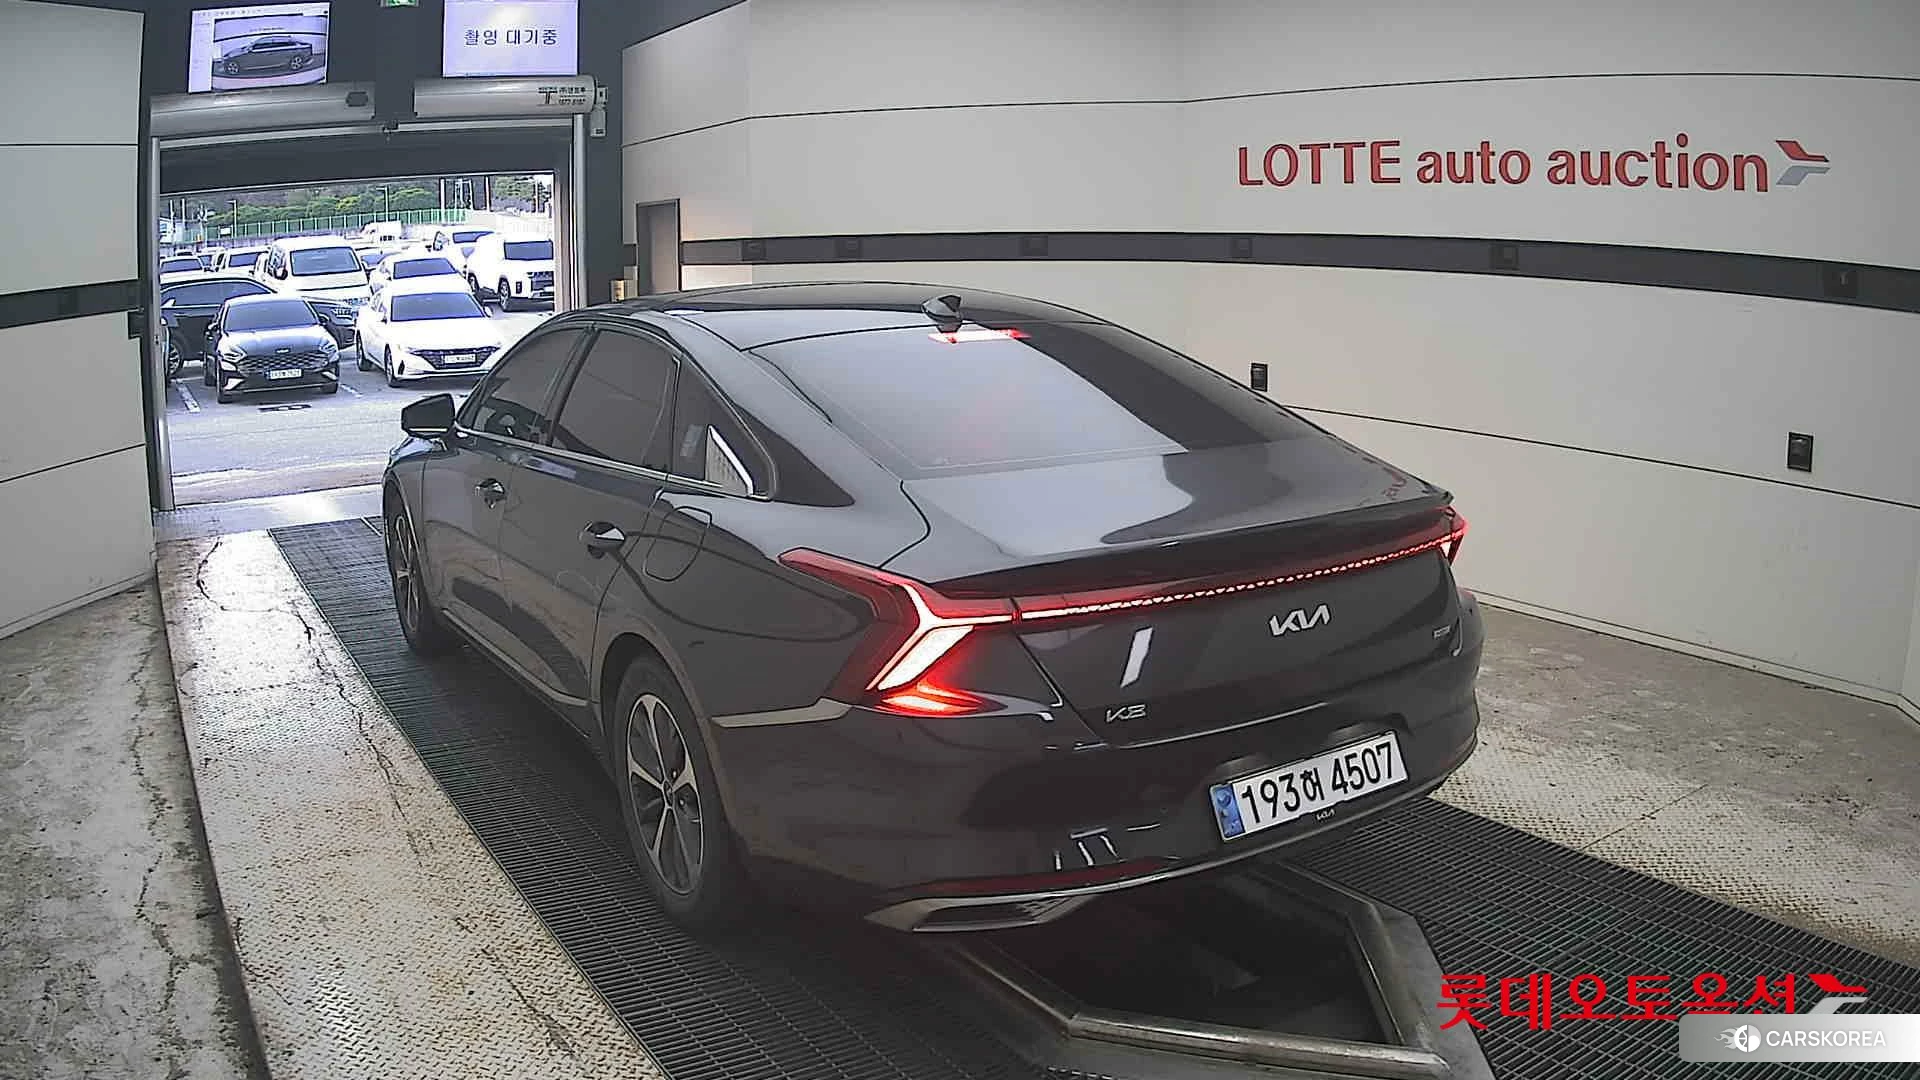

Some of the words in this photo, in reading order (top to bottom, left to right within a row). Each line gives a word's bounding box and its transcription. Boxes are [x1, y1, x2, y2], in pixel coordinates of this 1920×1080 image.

[464, 29, 497, 46] 촬영
[506, 29, 559, 46] 대기중
[1238, 140, 1401, 187] LOTTE
[1416, 140, 1531, 186] auto
[1546, 133, 1769, 193] auction
[1269, 604, 1331, 636] KIA
[1105, 703, 1147, 724] K8
[1241, 766, 1325, 824] 193허
[1331, 741, 1393, 794] 4507
